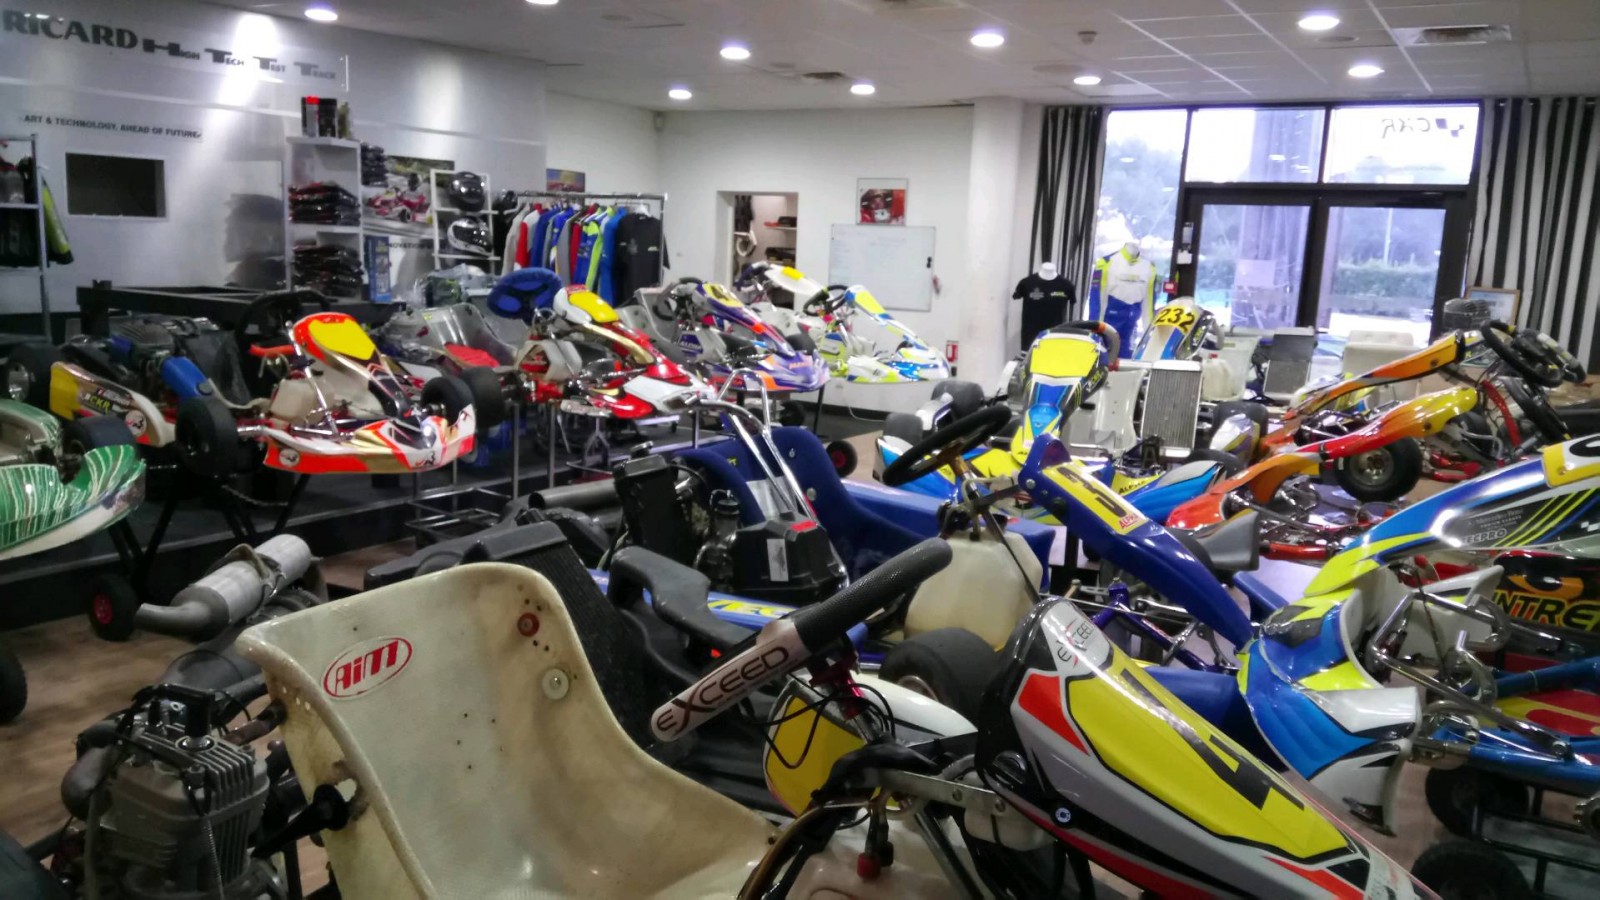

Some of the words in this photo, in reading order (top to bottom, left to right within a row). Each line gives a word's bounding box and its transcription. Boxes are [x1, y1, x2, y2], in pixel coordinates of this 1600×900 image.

[2, 9, 138, 49] RICARD
[24, 114, 43, 124] ART
[120, 124, 150, 135] AHEAD
[151, 127, 164, 135] OF
[1155, 307, 1195, 334] 232
